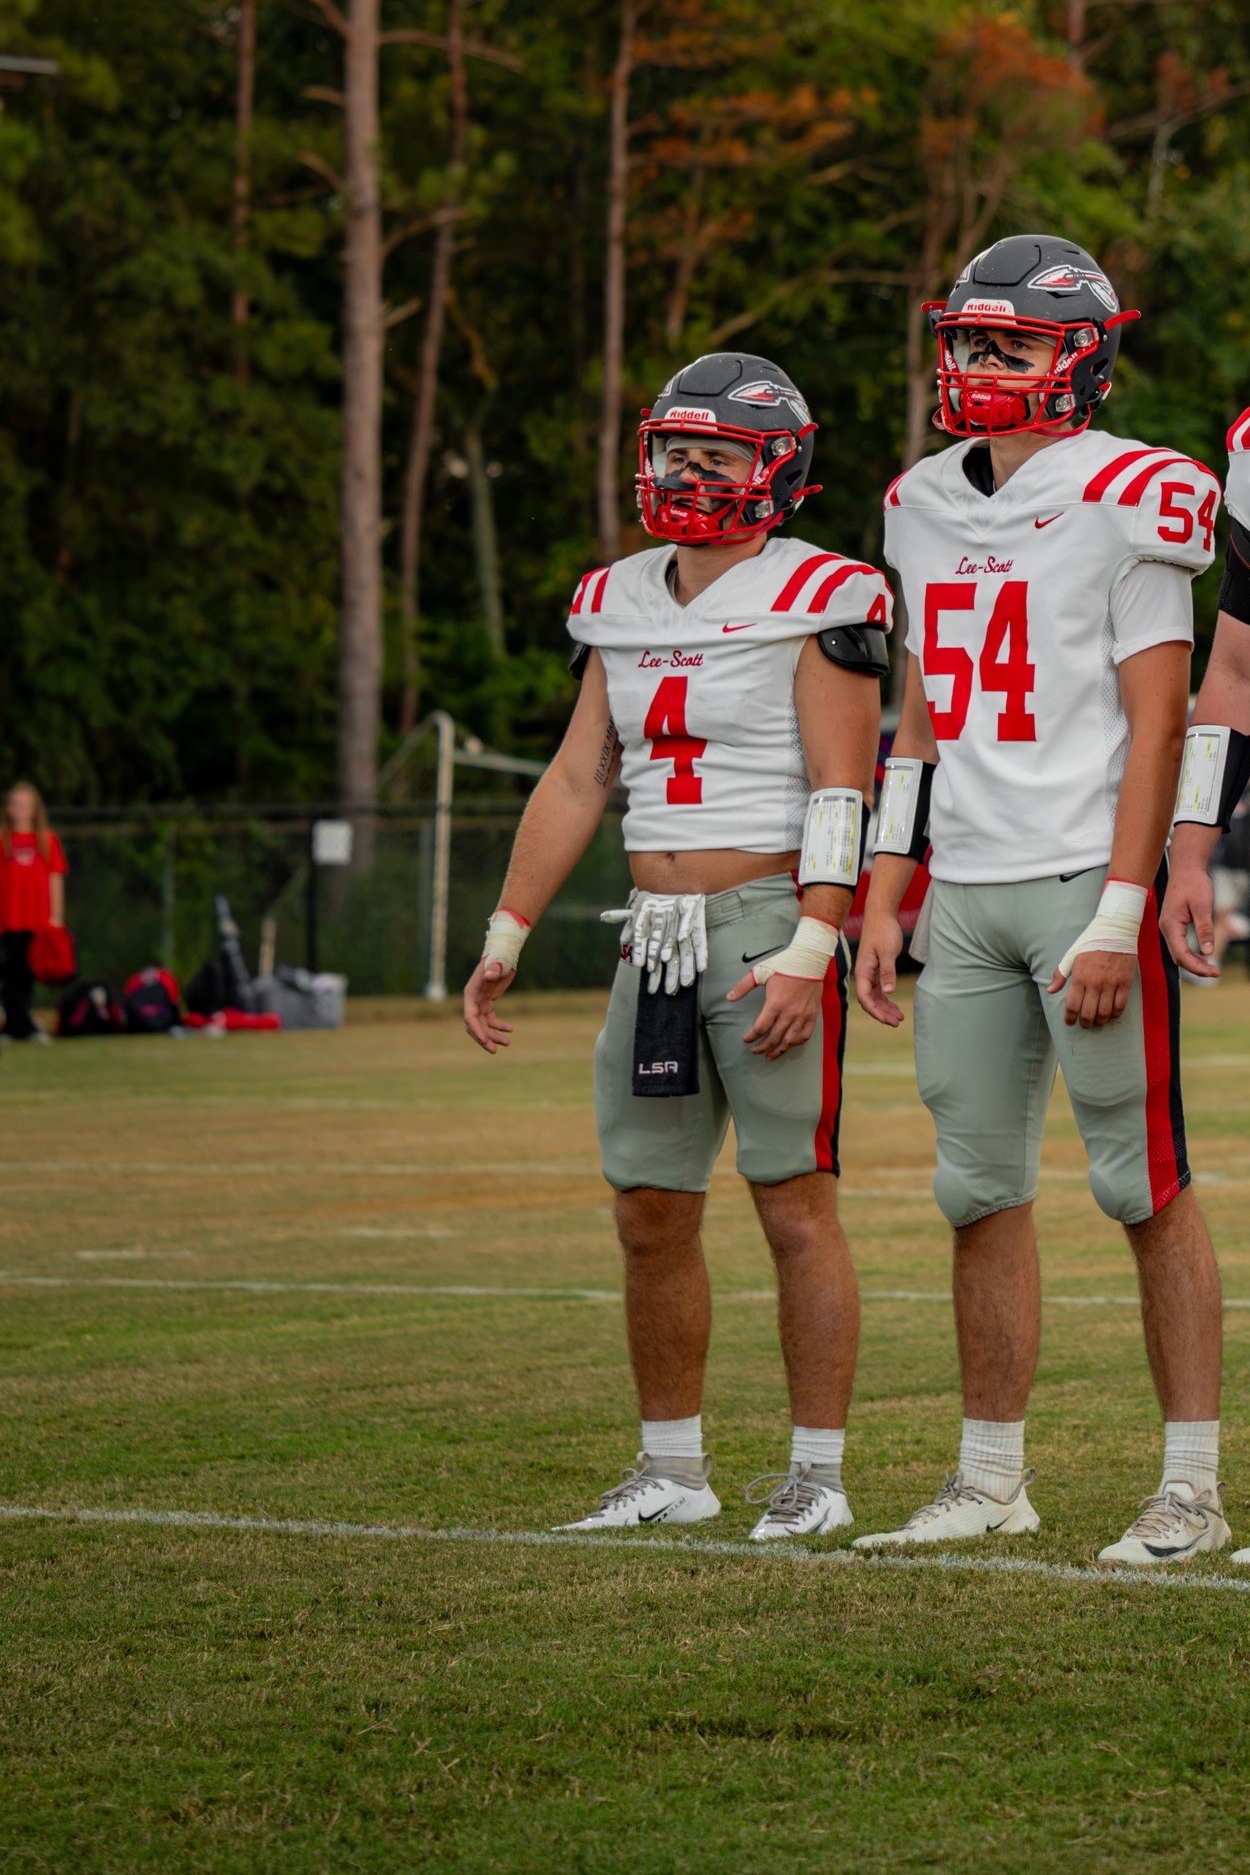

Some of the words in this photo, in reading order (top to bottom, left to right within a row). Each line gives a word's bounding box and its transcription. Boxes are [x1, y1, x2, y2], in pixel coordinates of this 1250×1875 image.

[967, 303, 1007, 313] Riddell
[669, 411, 709, 421] Riddell
[1157, 481, 1217, 553] 54
[955, 556, 1014, 575] Lee-Scott
[638, 650, 704, 668] Lee-Scott
[923, 581, 1037, 742] 54
[644, 676, 708, 805] 4
[638, 1061, 679, 1074] LSA
